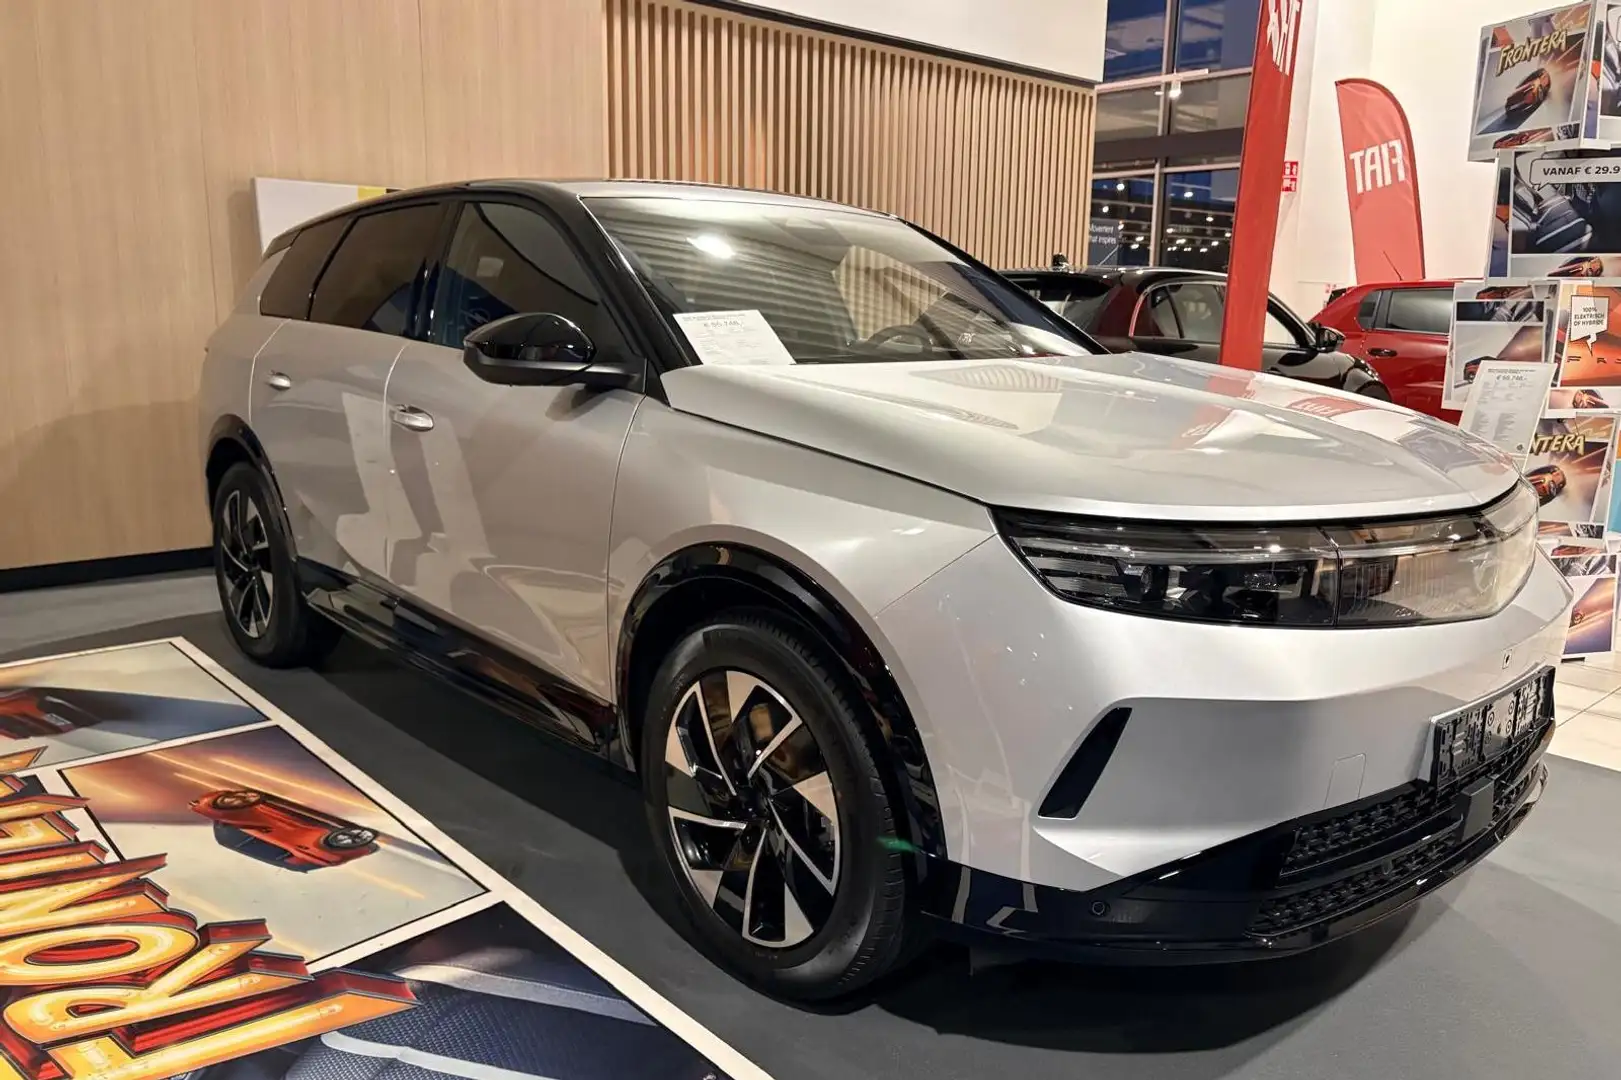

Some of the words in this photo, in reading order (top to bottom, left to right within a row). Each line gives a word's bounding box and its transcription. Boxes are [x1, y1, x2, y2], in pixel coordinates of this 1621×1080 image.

[1496, 29, 1568, 77] FRONTERA
[1543, 167, 1581, 176] VANAF
[1584, 166, 1592, 175] €
[1530, 433, 1585, 456] NTERA
